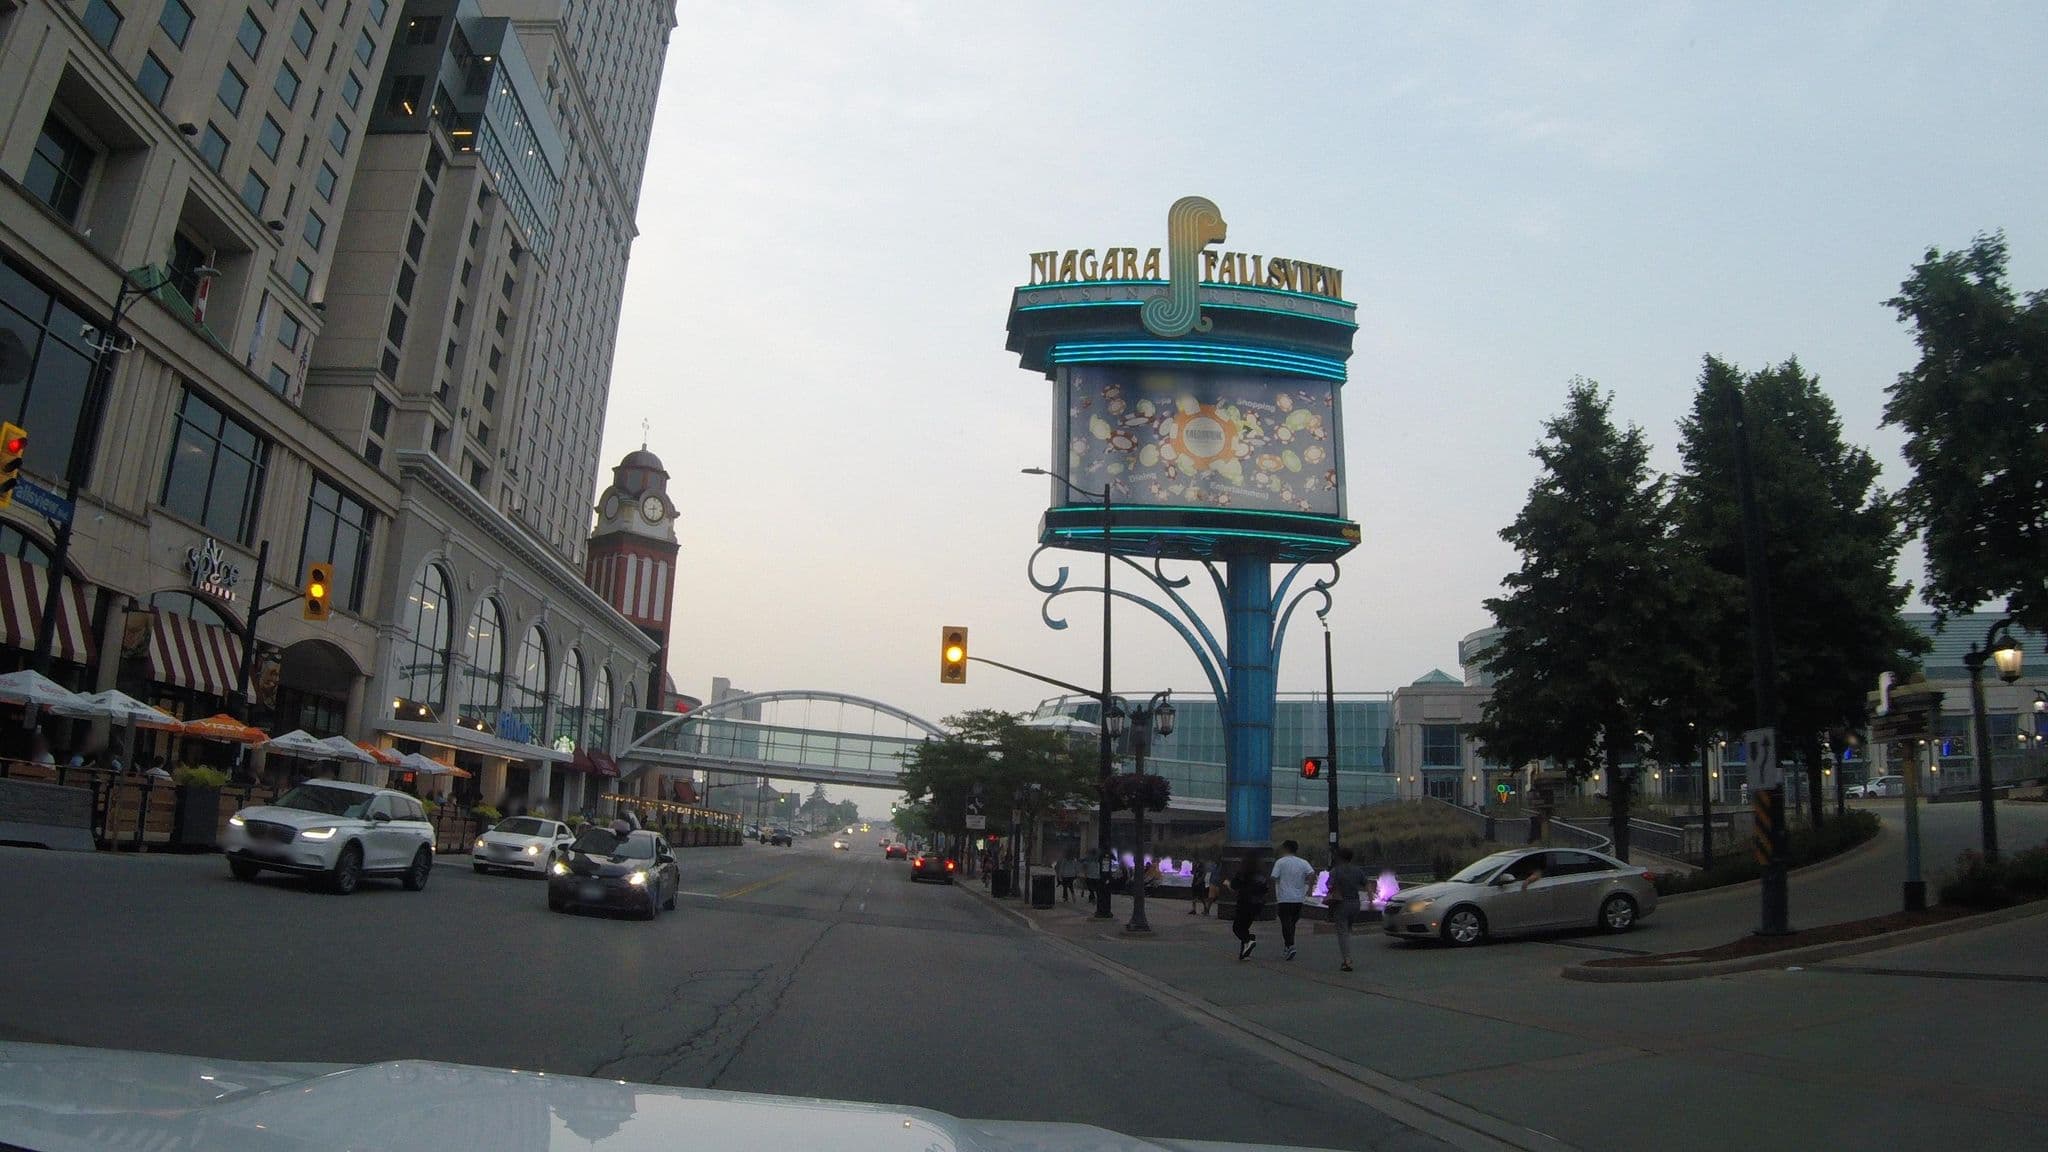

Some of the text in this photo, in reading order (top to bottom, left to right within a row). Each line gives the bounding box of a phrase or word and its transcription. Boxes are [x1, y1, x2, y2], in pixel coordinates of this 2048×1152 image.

[1029, 247, 1344, 300] NIAGARA FALLSVIEW
[1026, 286, 1349, 319] CASINO RESORT
[14, 480, 60, 514] allsview
